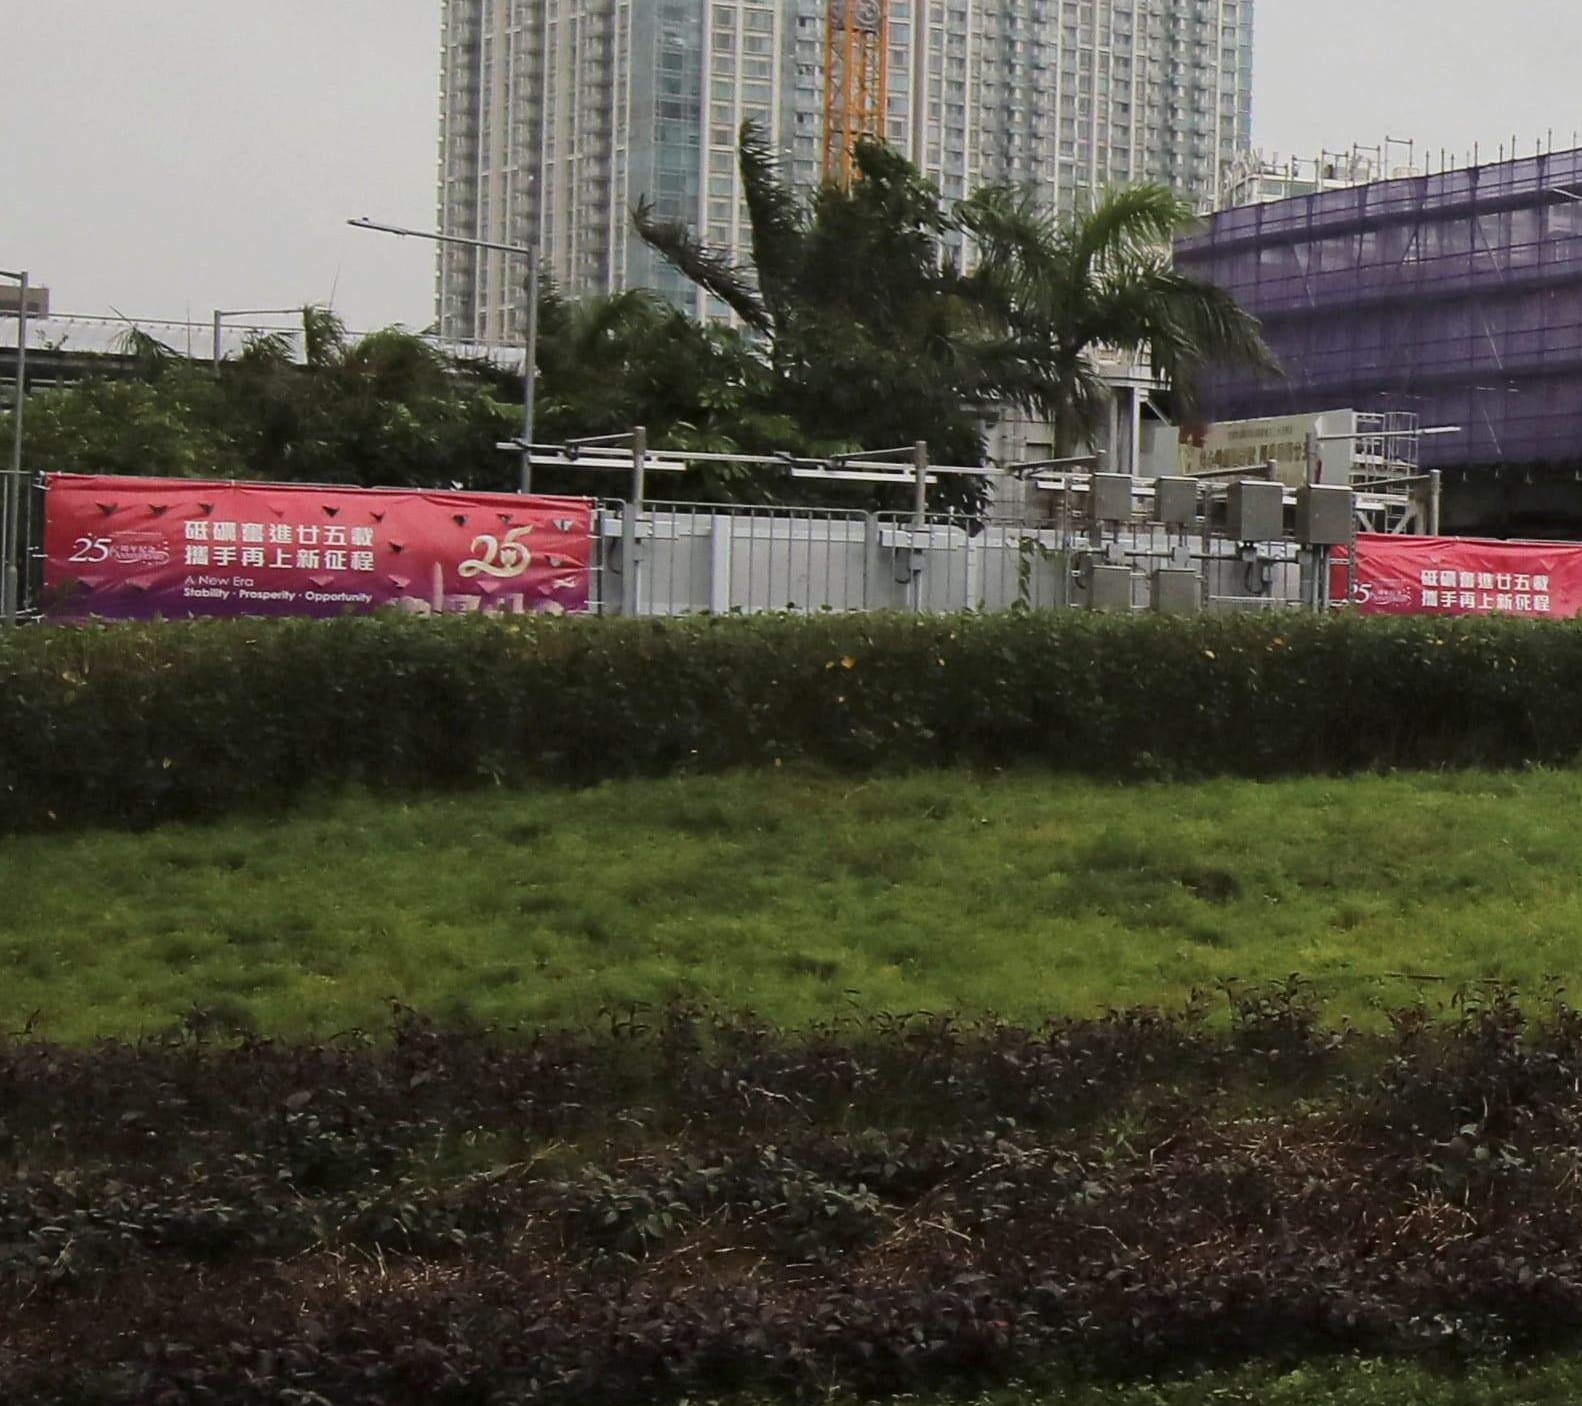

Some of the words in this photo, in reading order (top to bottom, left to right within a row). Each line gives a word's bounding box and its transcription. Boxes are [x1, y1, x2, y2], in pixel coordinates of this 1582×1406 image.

[68, 537, 113, 563] 25
[183, 544, 376, 572] 攜手再上新征程
[198, 576, 230, 587] New
[232, 577, 255, 588] Era
[304, 590, 374, 604] Opportunity
